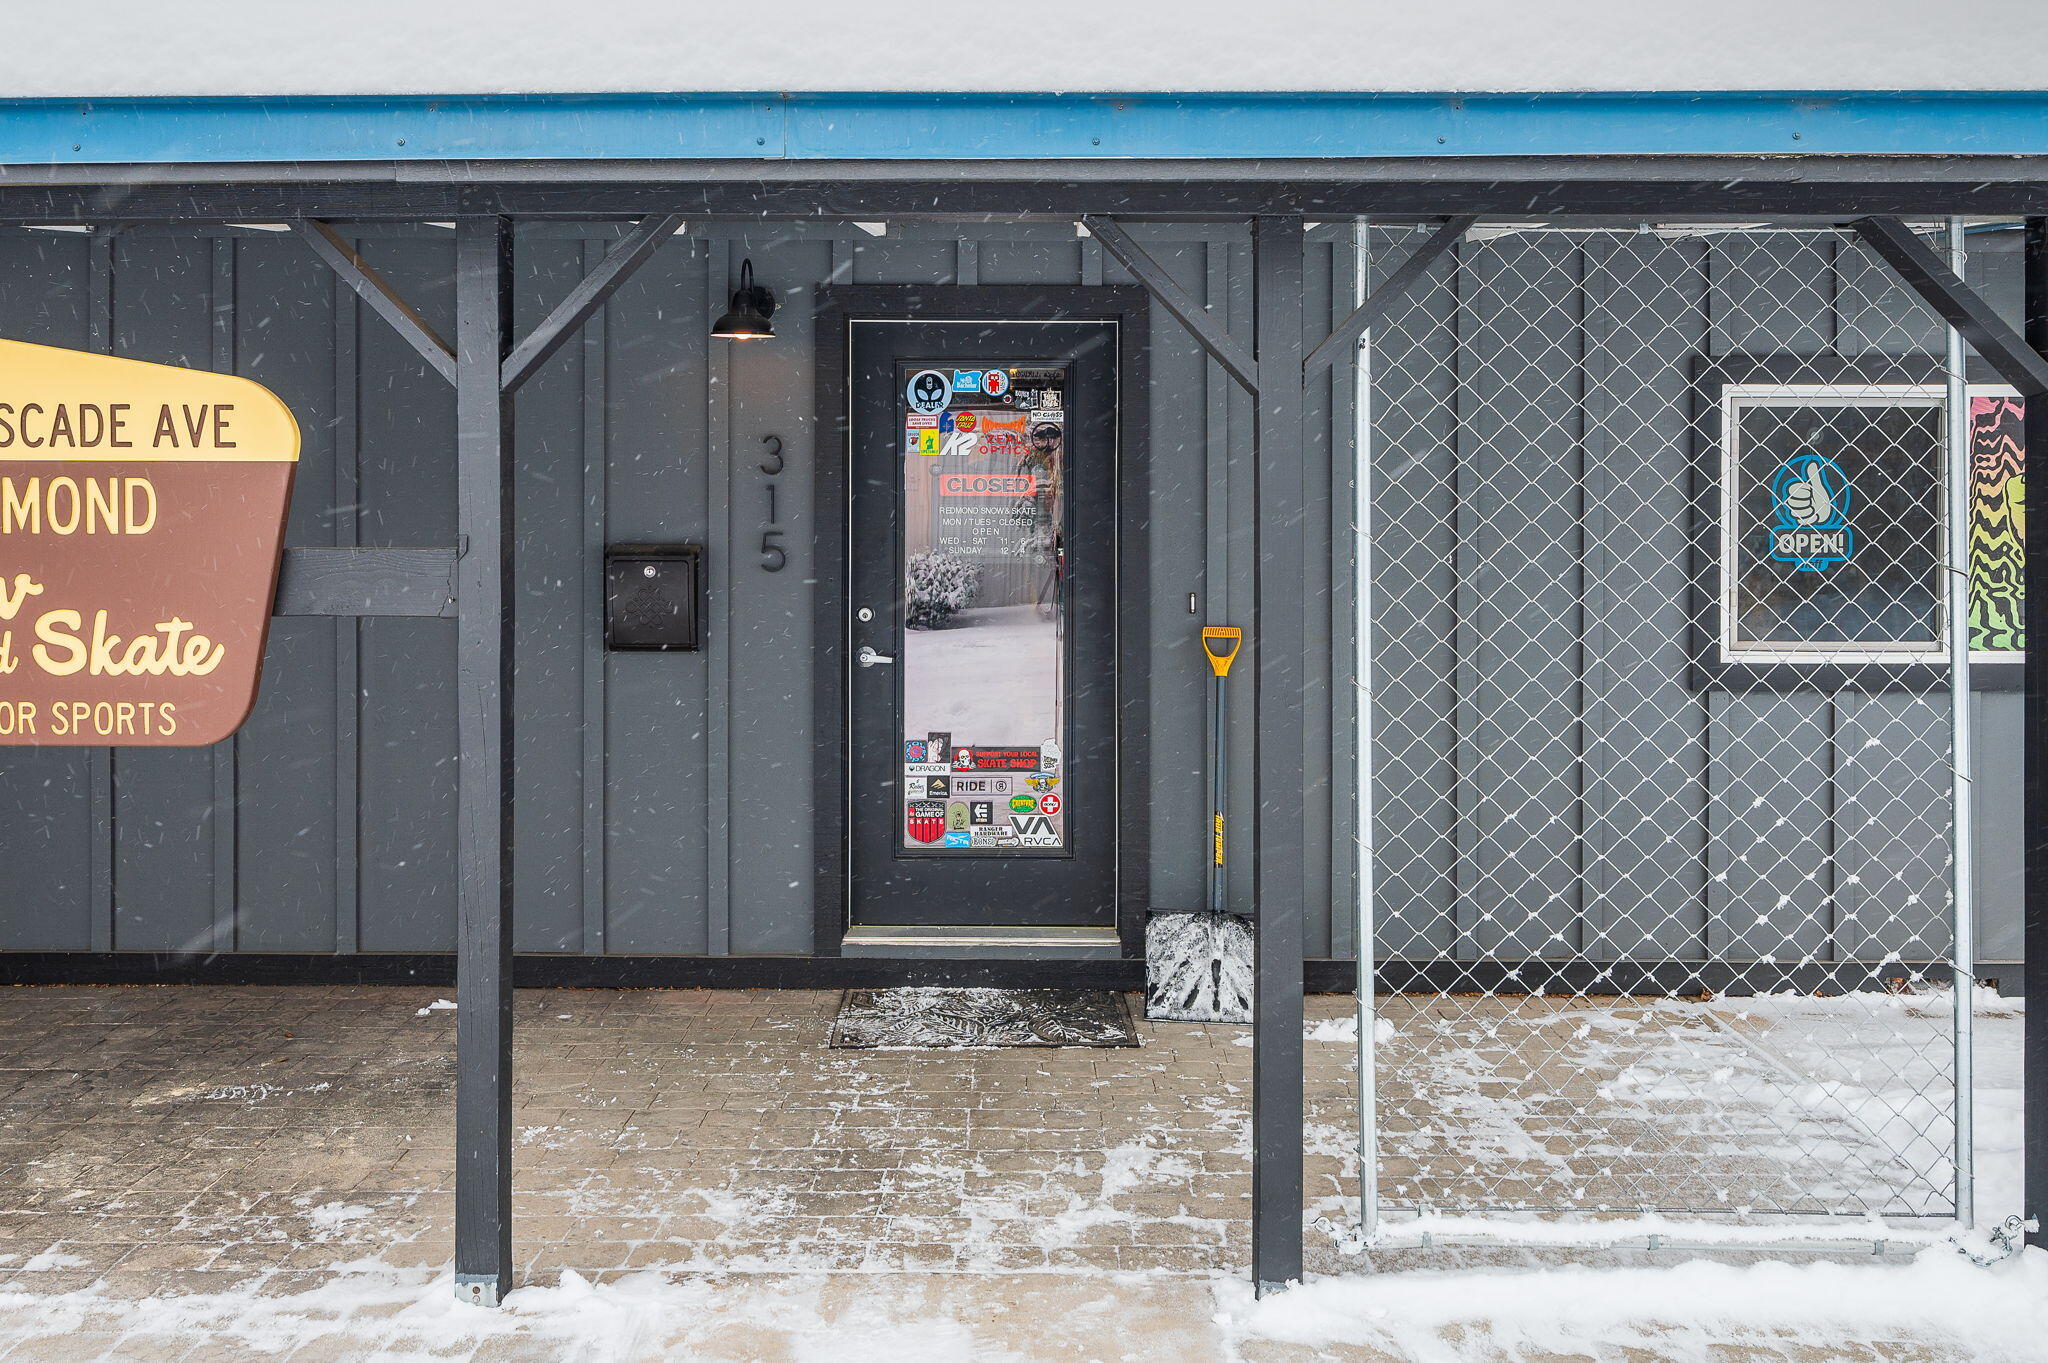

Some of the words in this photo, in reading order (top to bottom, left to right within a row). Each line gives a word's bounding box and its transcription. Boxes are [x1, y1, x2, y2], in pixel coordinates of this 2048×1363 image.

[153, 404, 236, 448] AVE
[940, 432, 978, 456] K2
[986, 434, 1023, 444] ZEAL
[979, 445, 1031, 455] OPTICS
[947, 477, 1030, 493] CLOSED
[2, 476, 158, 536] MOND
[939, 507, 978, 515] REDMOND
[1011, 507, 1037, 515] SKATE
[943, 518, 961, 526] MON
[999, 518, 1033, 526] CLOSED
[972, 527, 1000, 535] OPEN
[939, 537, 960, 545] WED
[972, 537, 987, 545] SAT
[1000, 537, 1008, 545] 11
[1020, 537, 1026, 545] 6
[1778, 533, 1844, 554] OPEN!
[1000, 547, 1009, 555] 12
[32, 608, 225, 677] Skate
[51, 701, 177, 736] SPORTS
[977, 759, 1007, 768] SKATE
[1010, 759, 1038, 768] SHOP
[956, 781, 986, 791] RIDE
